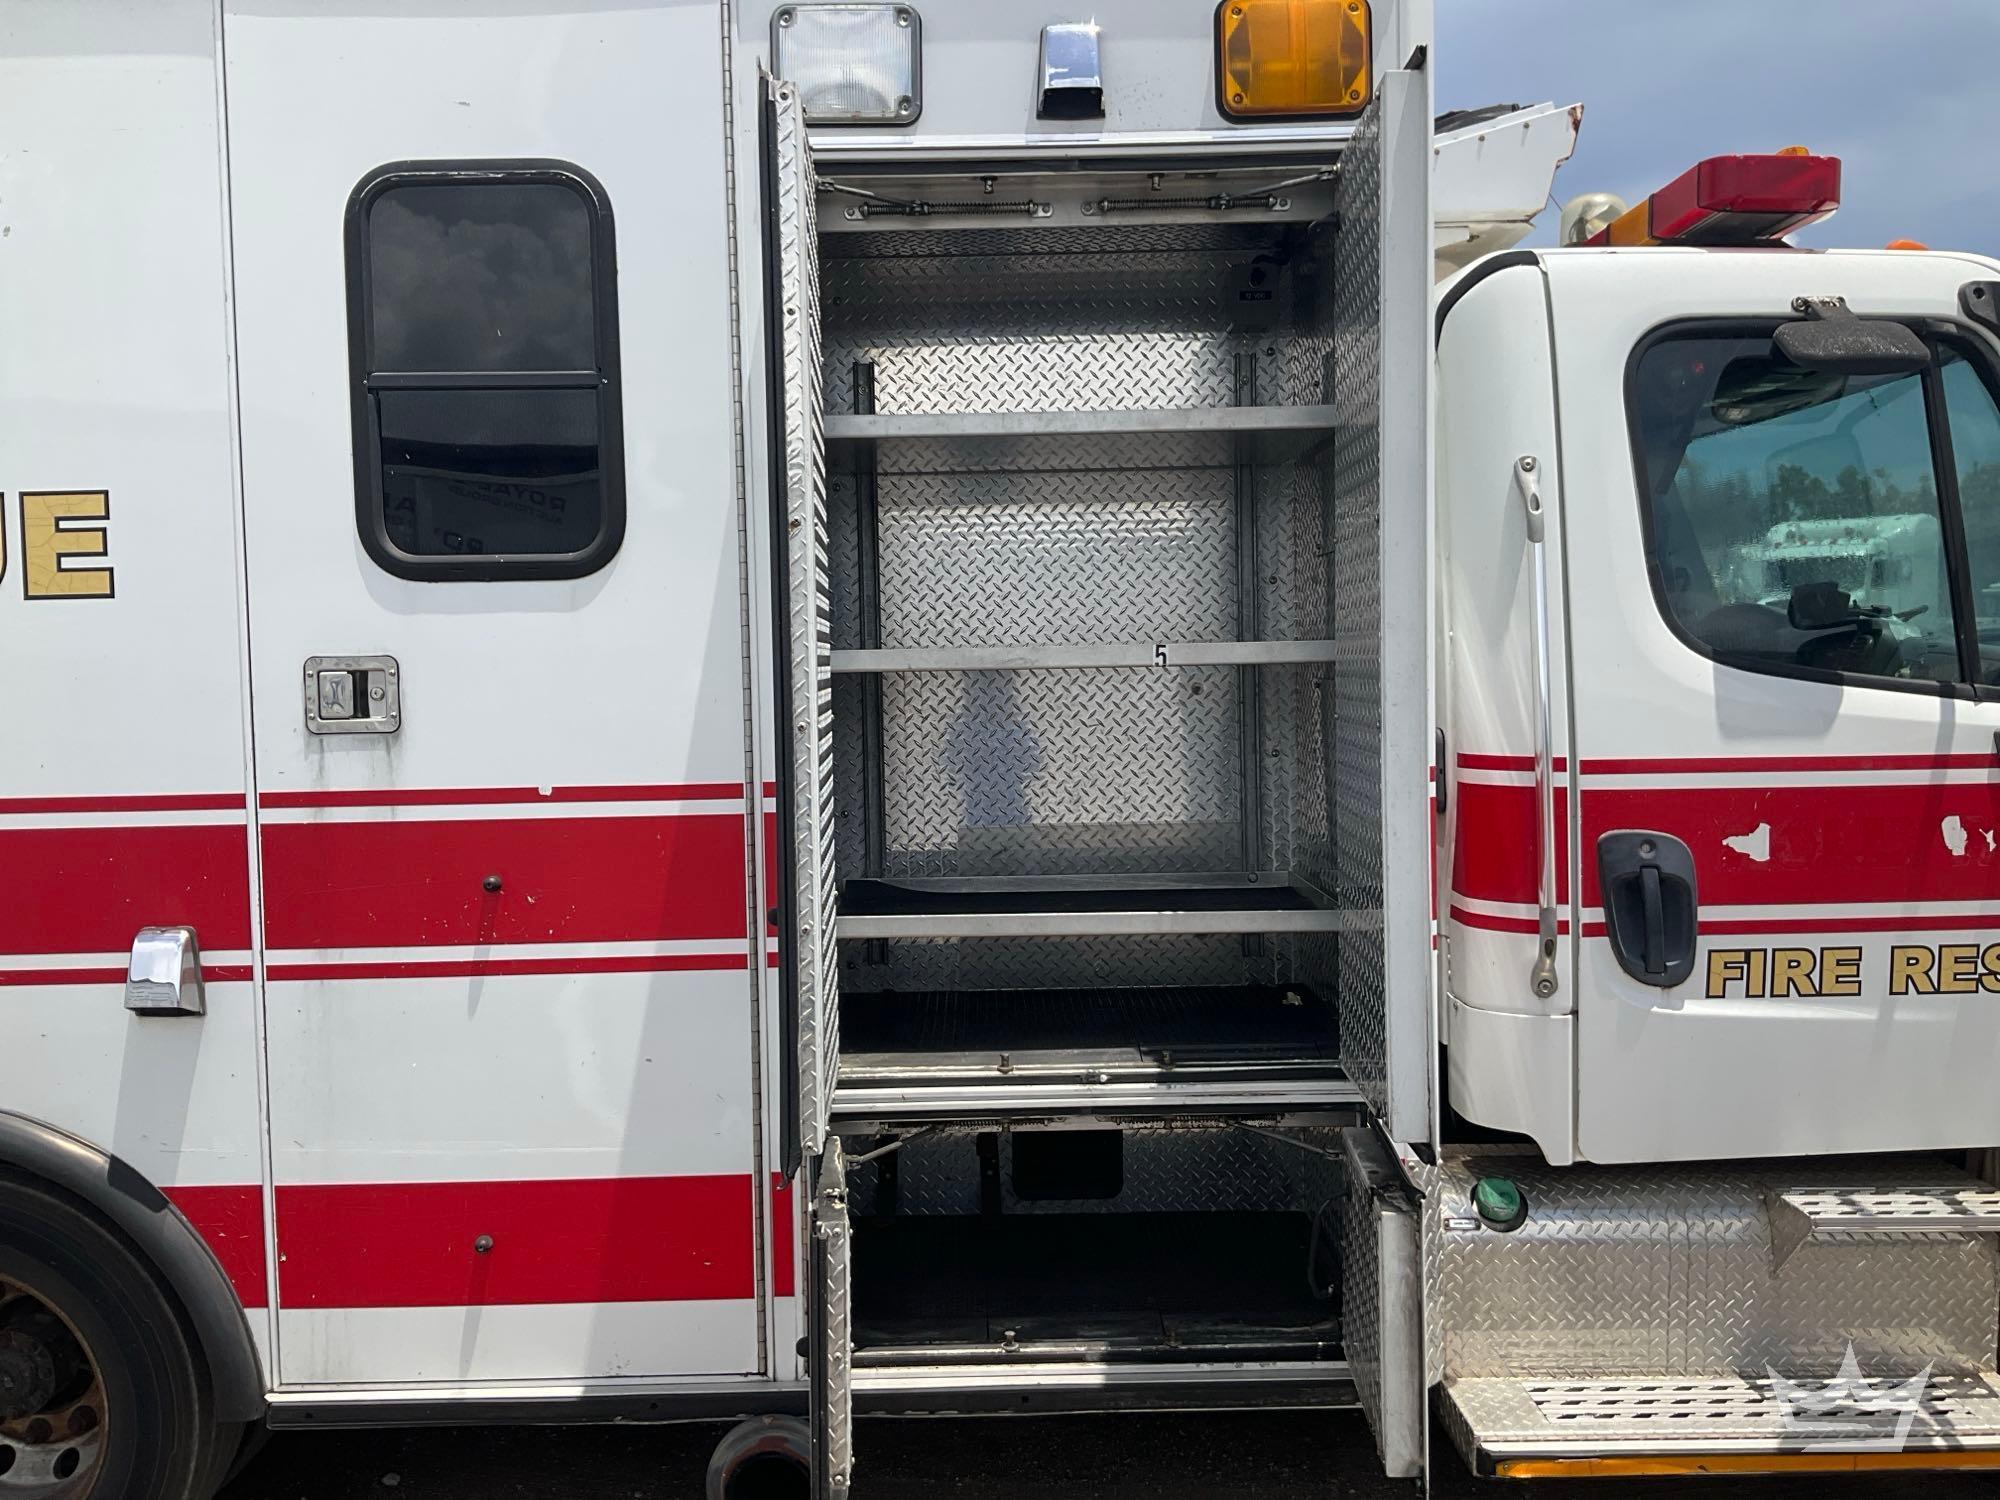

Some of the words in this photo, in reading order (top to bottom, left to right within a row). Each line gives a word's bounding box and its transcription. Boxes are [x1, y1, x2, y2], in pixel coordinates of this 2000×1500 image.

[0, 489, 115, 600] E
[1155, 644, 1166, 667] 5
[1705, 946, 1862, 998] FIRE
